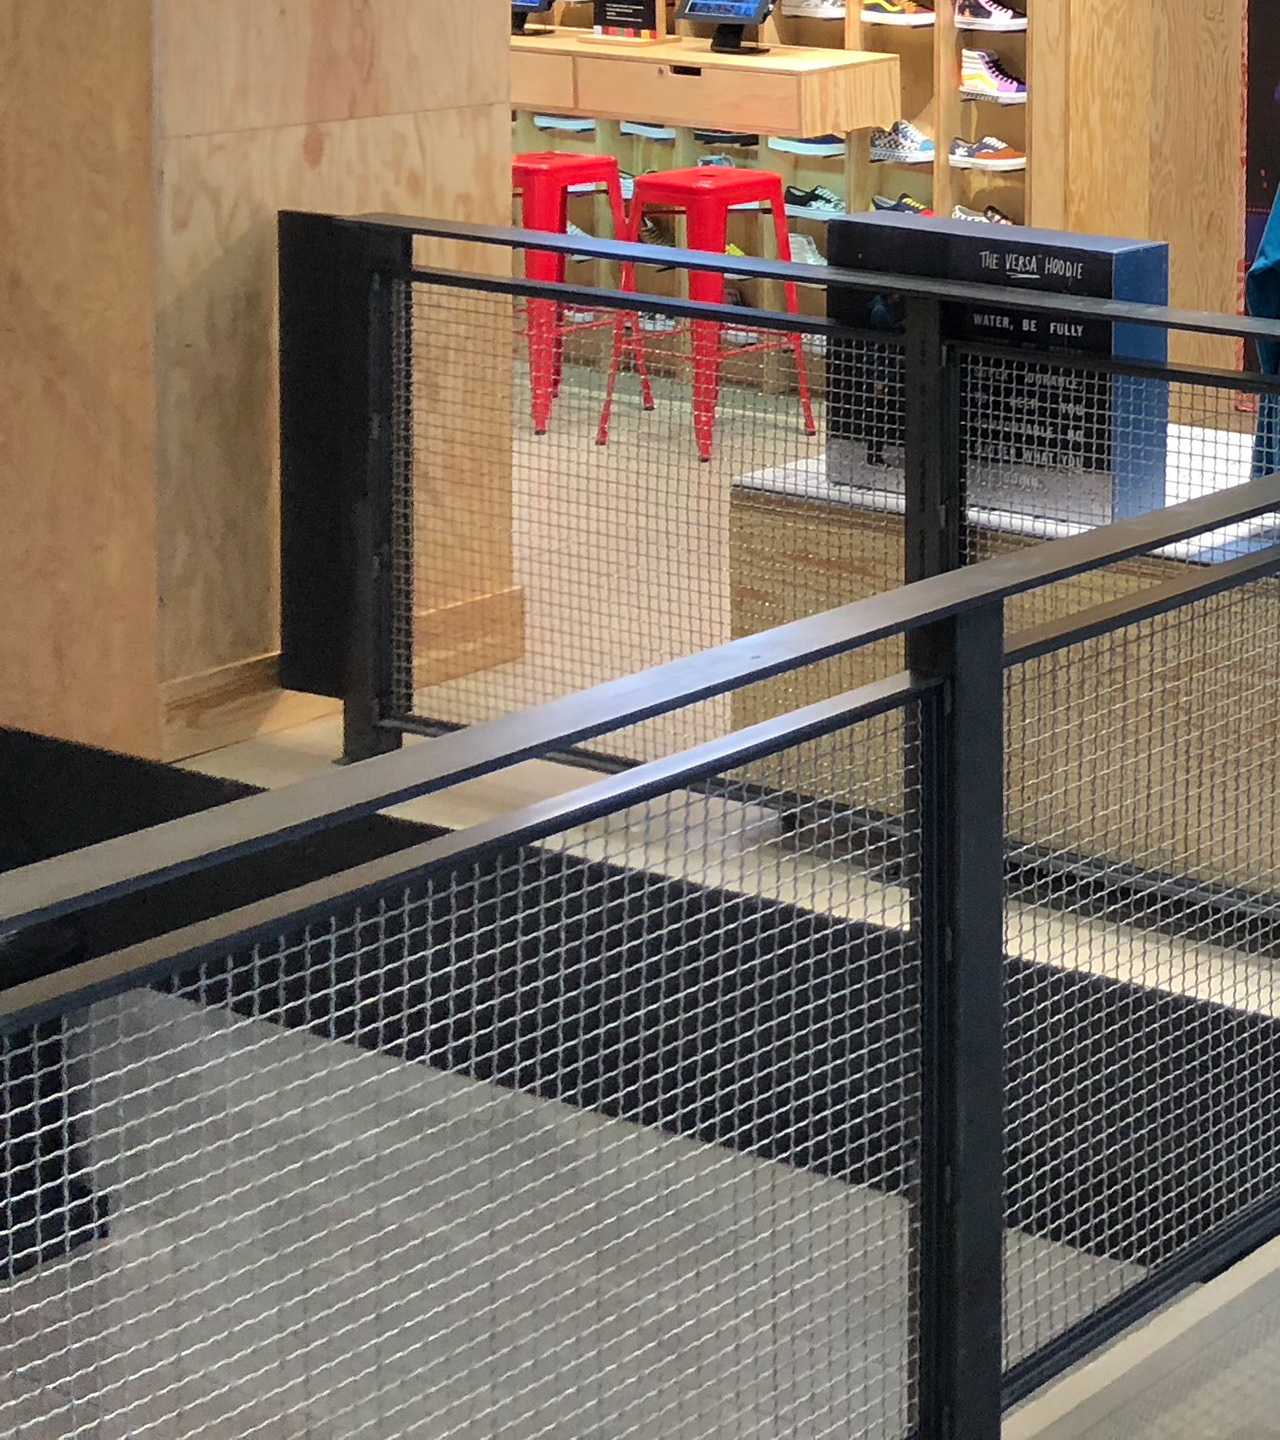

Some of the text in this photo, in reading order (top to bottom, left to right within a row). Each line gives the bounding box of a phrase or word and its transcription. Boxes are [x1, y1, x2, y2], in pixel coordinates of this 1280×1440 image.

[979, 250, 1000, 270] THE
[1044, 257, 1084, 279] HOODIE
[973, 313, 1084, 337] WATER, BE FULLY
